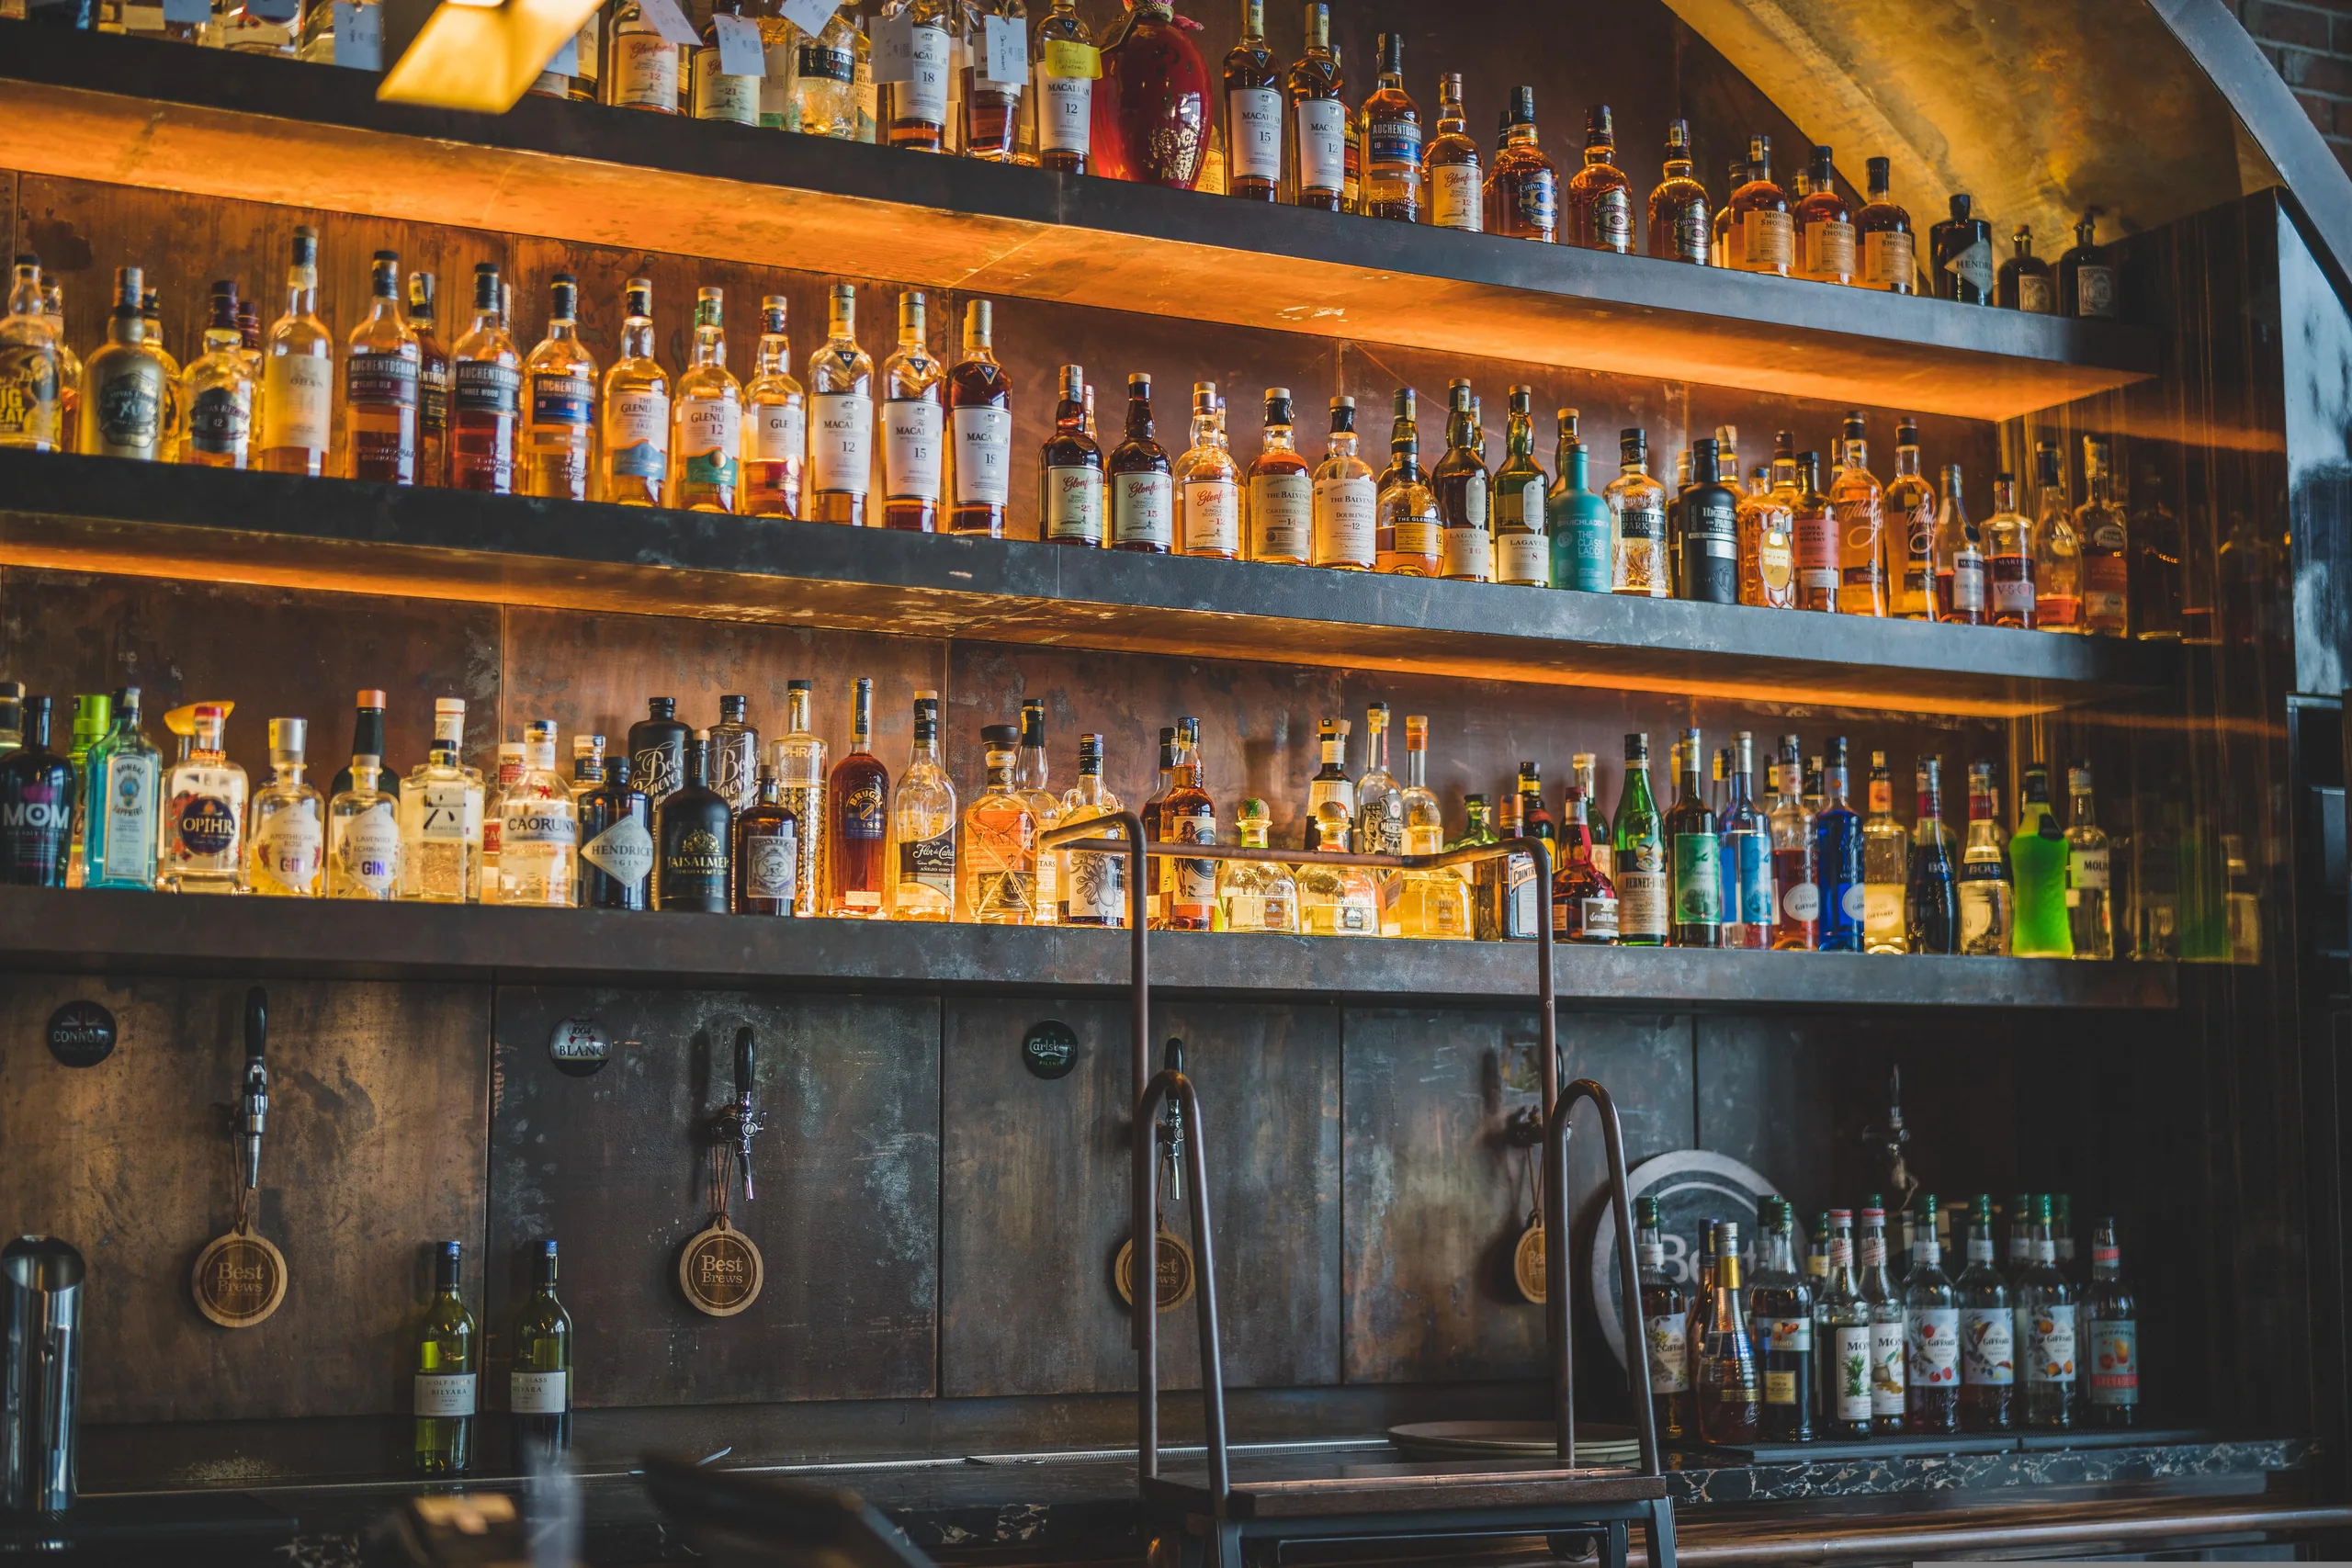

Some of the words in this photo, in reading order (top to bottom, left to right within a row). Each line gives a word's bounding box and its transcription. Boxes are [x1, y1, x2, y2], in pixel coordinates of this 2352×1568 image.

[1065, 20, 1073, 28] 12
[913, 51, 947, 65] ACALLAN
[1323, 62, 1331, 71] 12
[648, 72, 662, 81] 12
[922, 72, 935, 83] 18
[1047, 83, 1090, 96] MACALLN
[1066, 103, 1078, 115] 12
[1259, 131, 1272, 142] 15
[1328, 142, 1339, 153] 12
[1594, 205, 1617, 215] CHIVAS
[351, 359, 416, 376] AUCHENTOSHAN
[914, 360, 922, 368] 15
[290, 378, 323, 389] OBAN
[481, 389, 500, 398] WOOD
[621, 403, 665, 416] GLENLIT
[709, 405, 724, 413] THE
[212, 418, 222, 428] 12
[691, 412, 739, 427] GLENLIT
[711, 424, 724, 435] 12
[824, 421, 870, 432] MACALN
[896, 427, 941, 438] MACALN
[967, 433, 1009, 446] MACALAN
[842, 441, 855, 453] 12
[914, 447, 927, 458] 15
[985, 453, 997, 465] 18
[1080, 504, 1091, 513] 25
[1147, 510, 1158, 518] 15
[1702, 507, 1736, 521] HIGHLAN
[1216, 517, 1226, 525] 12
[1623, 513, 1666, 525] HIGHLAN
[1623, 522, 1649, 530] PARK
[1435, 534, 1442, 545] 12
[1577, 530, 1594, 539] THE
[1577, 538, 1607, 548] CLASSI
[1532, 552, 1538, 561] 8
[1577, 547, 1605, 556] LADDIE
[784, 747, 827, 760] PHRAYA
[634, 741, 684, 783] Bols
[849, 790, 884, 808] BRUGAL
[4, 803, 70, 829] MOM
[184, 815, 236, 834] OPIHR
[508, 818, 576, 832] CAORUNN
[912, 843, 933, 859] Flor
[938, 845, 955, 860] Caña
[279, 858, 305, 873] GIN
[666, 856, 729, 869] JAISALMER
[361, 861, 386, 876] GIN
[1968, 863, 2001, 875] BOLS
[944, 879, 950, 888] 4
[559, 1044, 606, 1056] BLANC
[701, 1255, 743, 1272] Best
[217, 1262, 264, 1280] Best
[702, 1272, 743, 1284] Brews
[217, 1280, 264, 1292] Brews
[1927, 1338, 1956, 1348] GIFFARD
[1983, 1337, 2010, 1347] GIFFARD
[2046, 1334, 2073, 1343] GIFFARD
